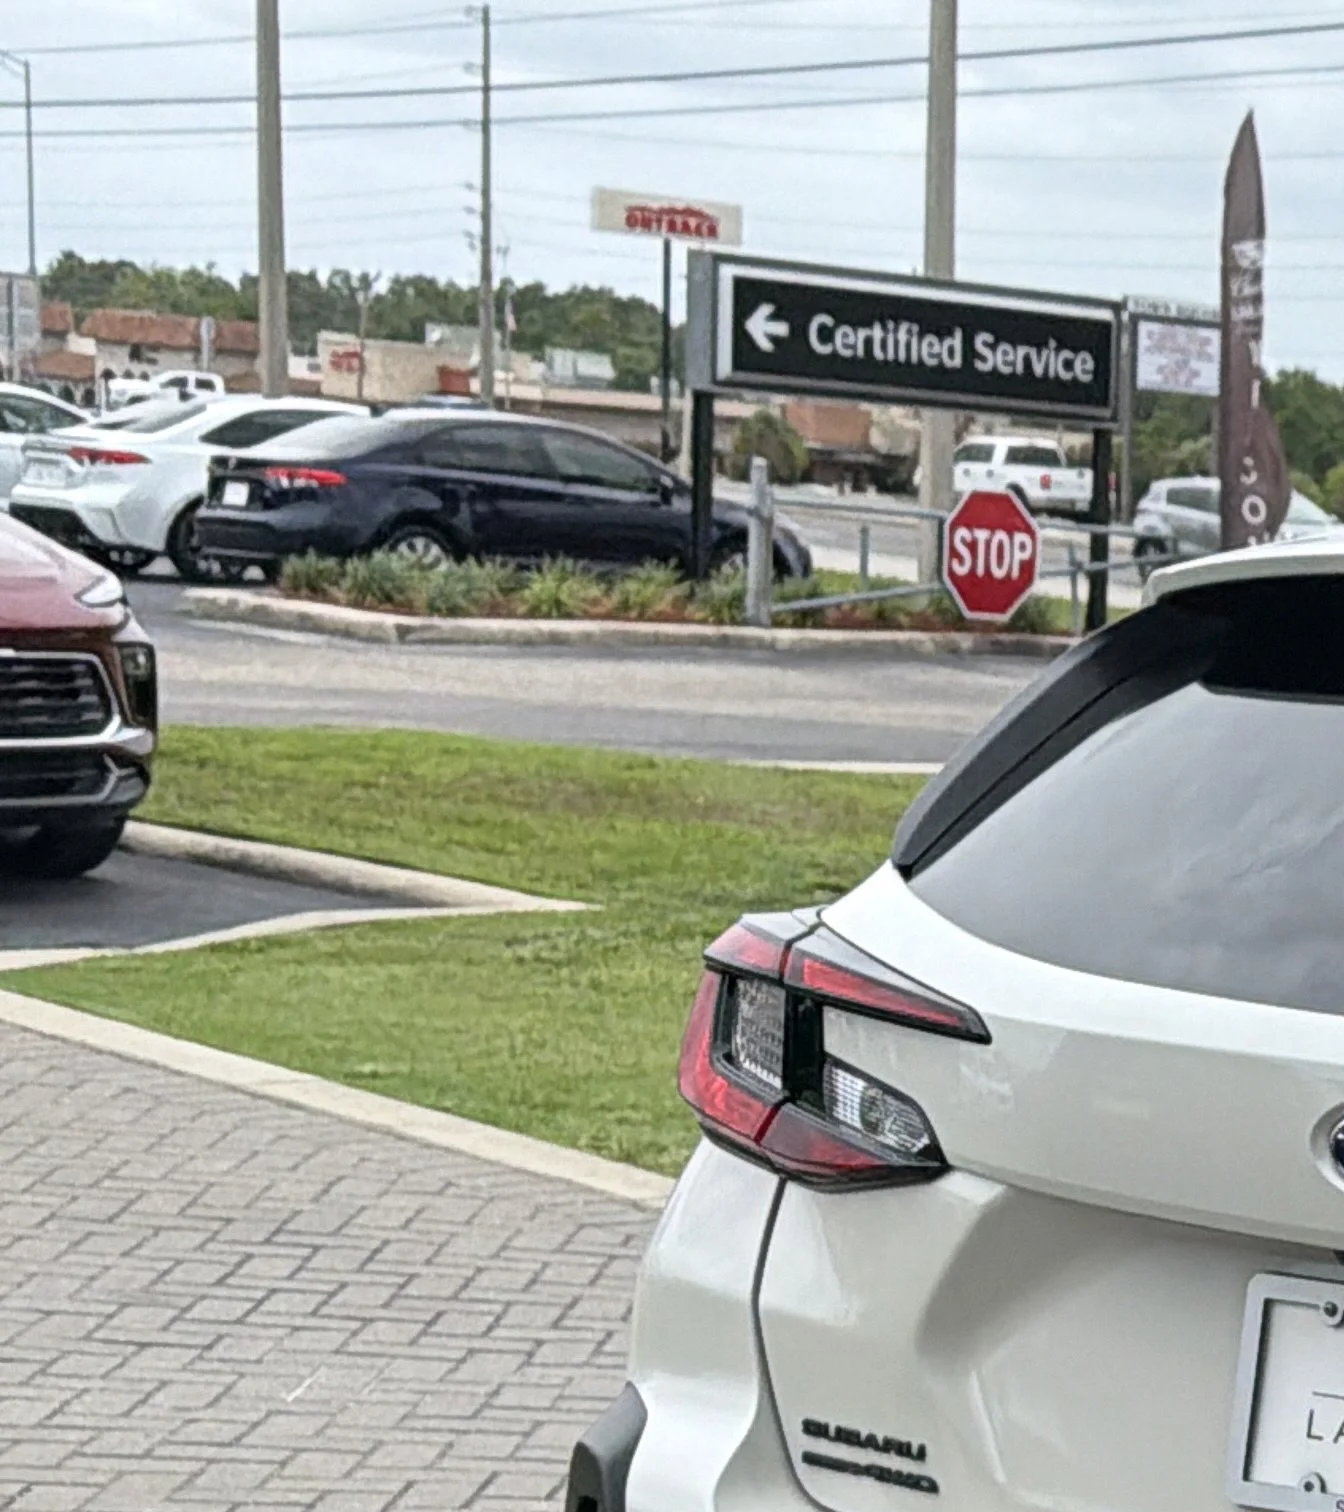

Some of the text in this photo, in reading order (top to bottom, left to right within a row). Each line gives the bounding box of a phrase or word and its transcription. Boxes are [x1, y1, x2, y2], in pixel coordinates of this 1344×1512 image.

[808, 315, 962, 369] Certified
[974, 332, 1094, 382] Service
[951, 527, 1032, 578] STOP
[802, 1418, 927, 1462] SUBARU
